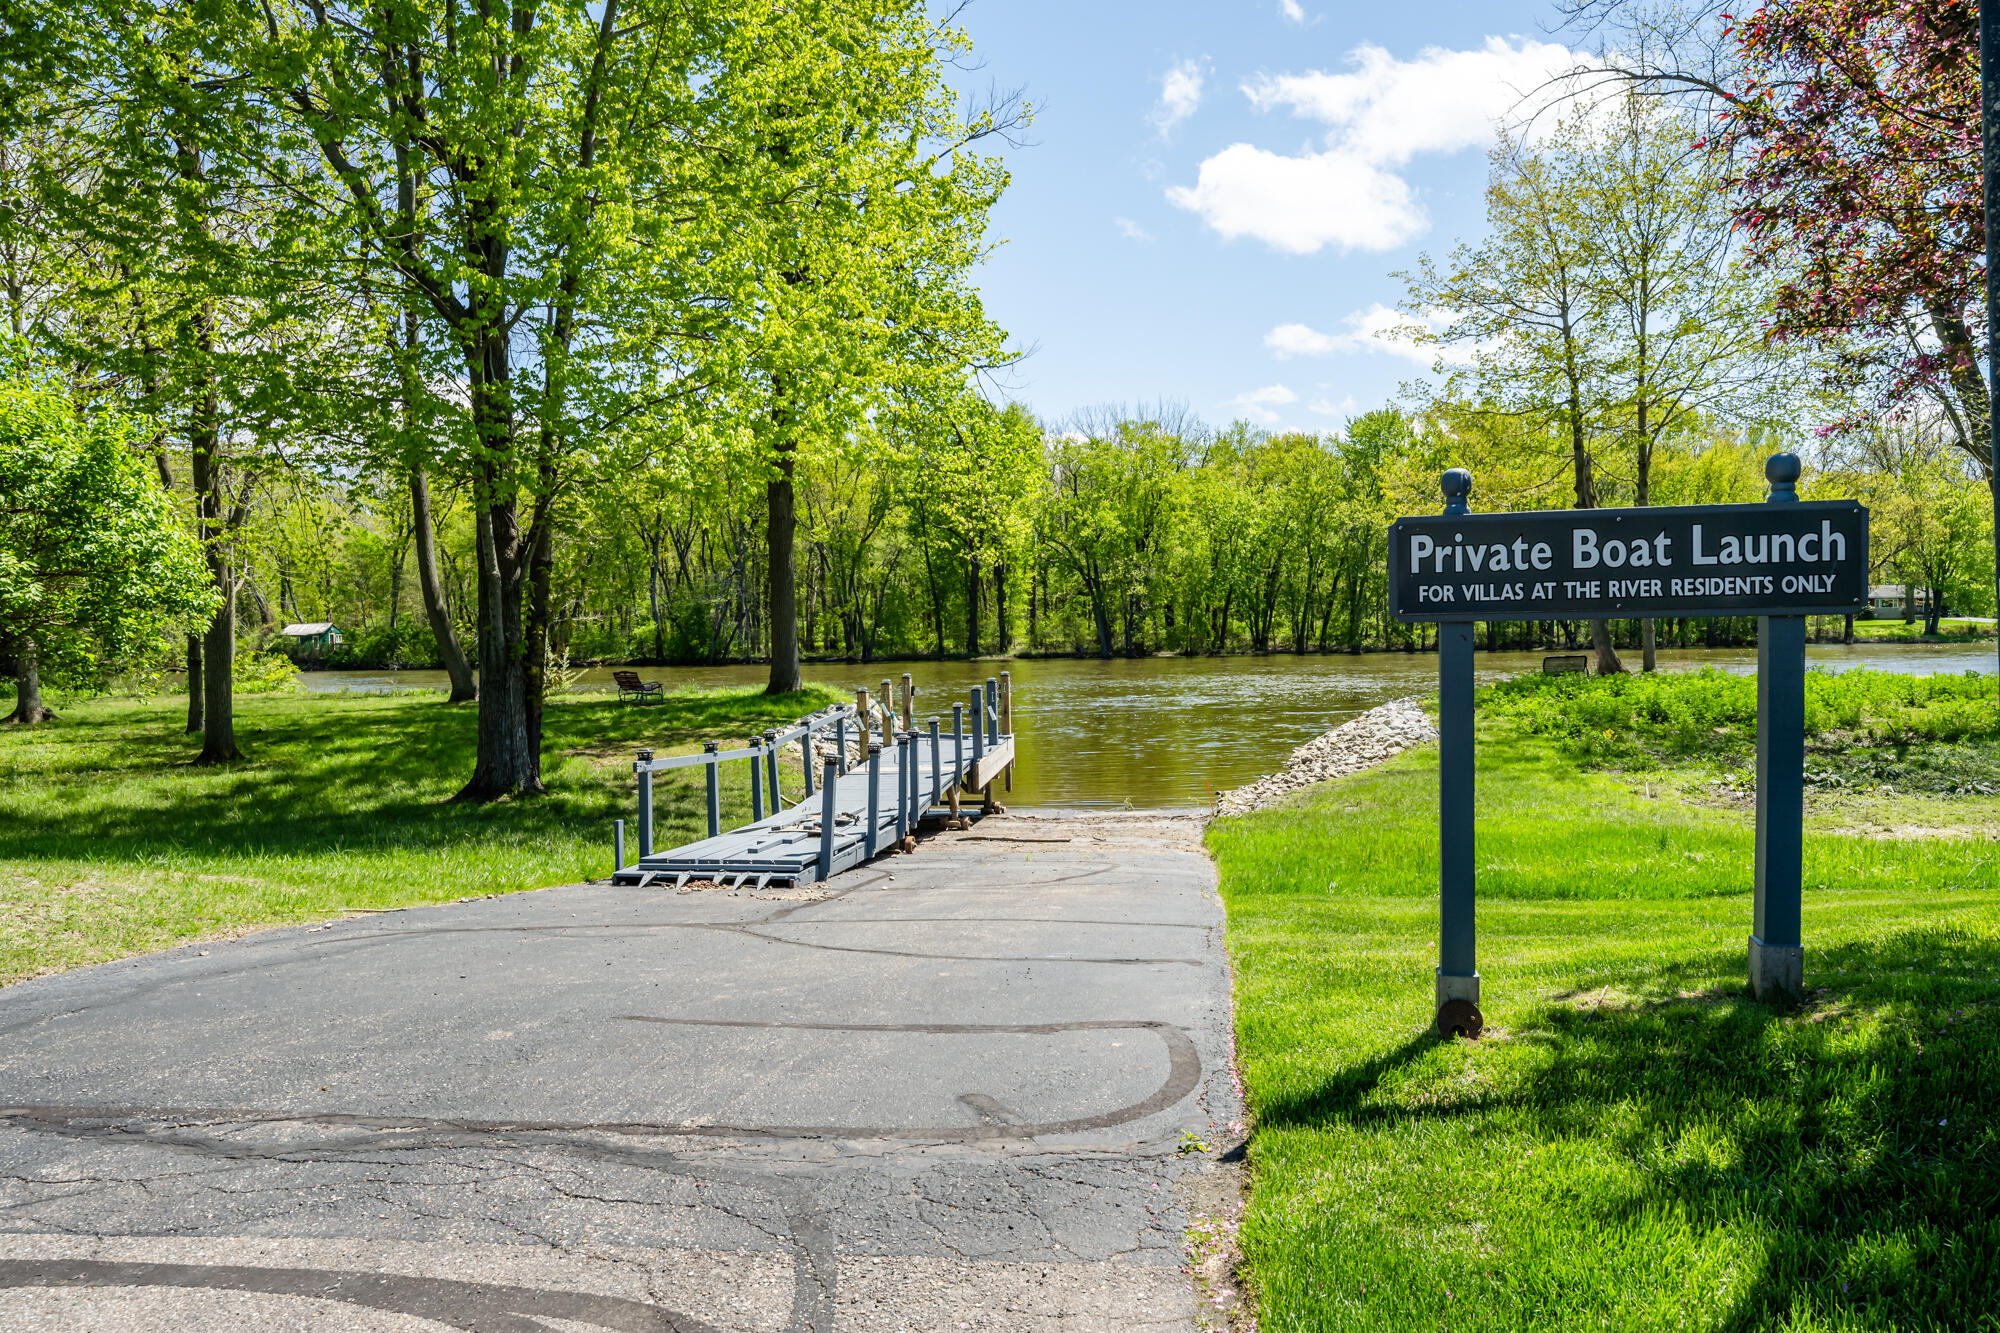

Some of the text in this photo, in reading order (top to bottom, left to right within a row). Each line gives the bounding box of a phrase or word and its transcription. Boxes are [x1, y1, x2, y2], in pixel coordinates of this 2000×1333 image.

[1410, 520, 1846, 574] Private Boat Launch
[1419, 574, 1836, 602] FOR VILLAS AT THE RIVER RESIDENTS ONLY
